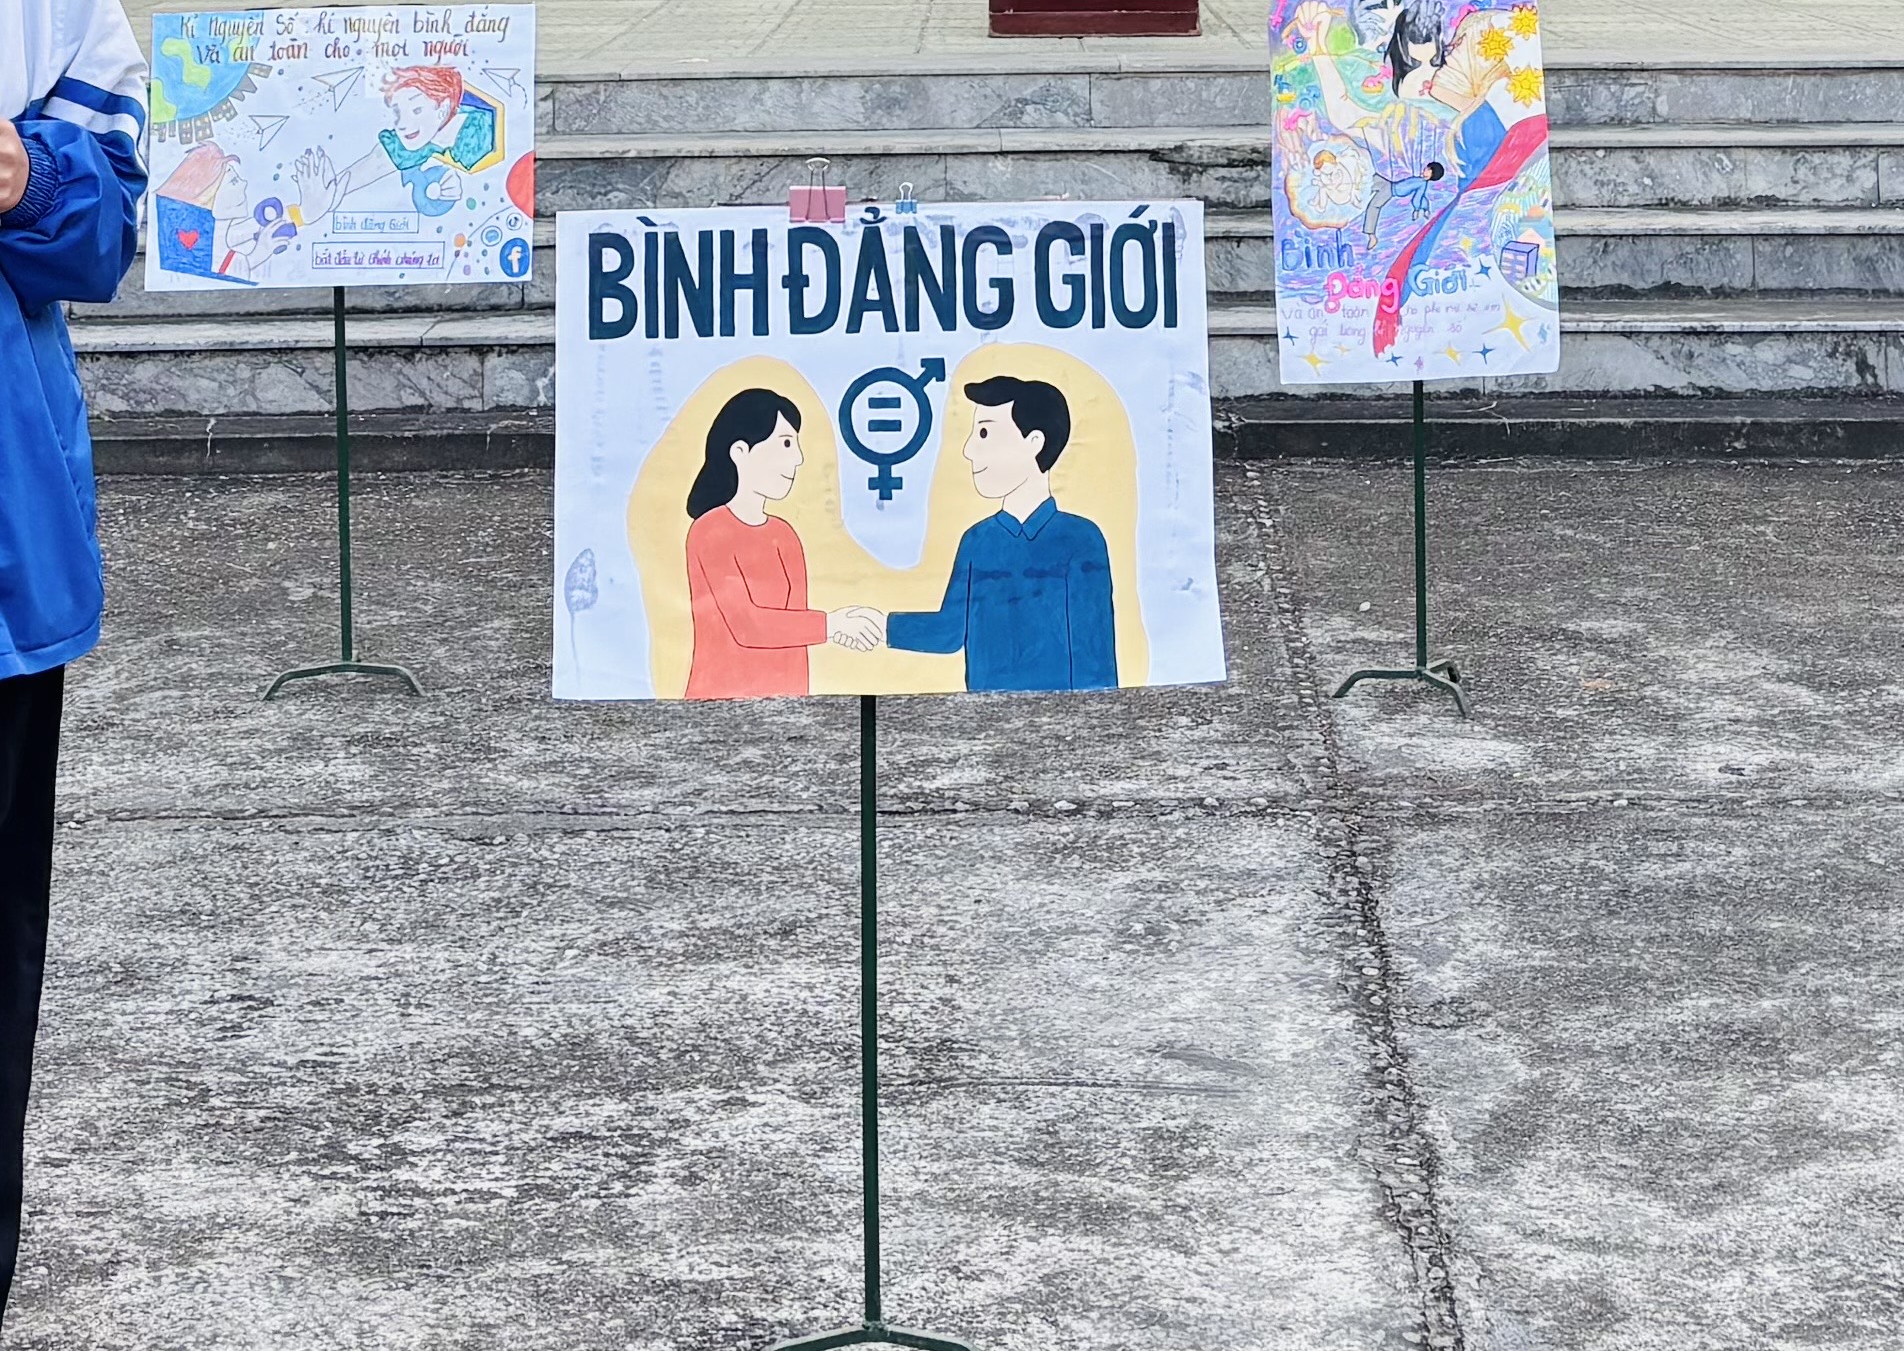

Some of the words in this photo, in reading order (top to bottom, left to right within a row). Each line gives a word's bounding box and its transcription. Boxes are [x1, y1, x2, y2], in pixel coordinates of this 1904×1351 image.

[324, 37, 351, 59] cho
[588, 215, 770, 340] BÌNH
[781, 206, 1015, 335] ĐẲNG
[1034, 204, 1179, 330] GIỚI
